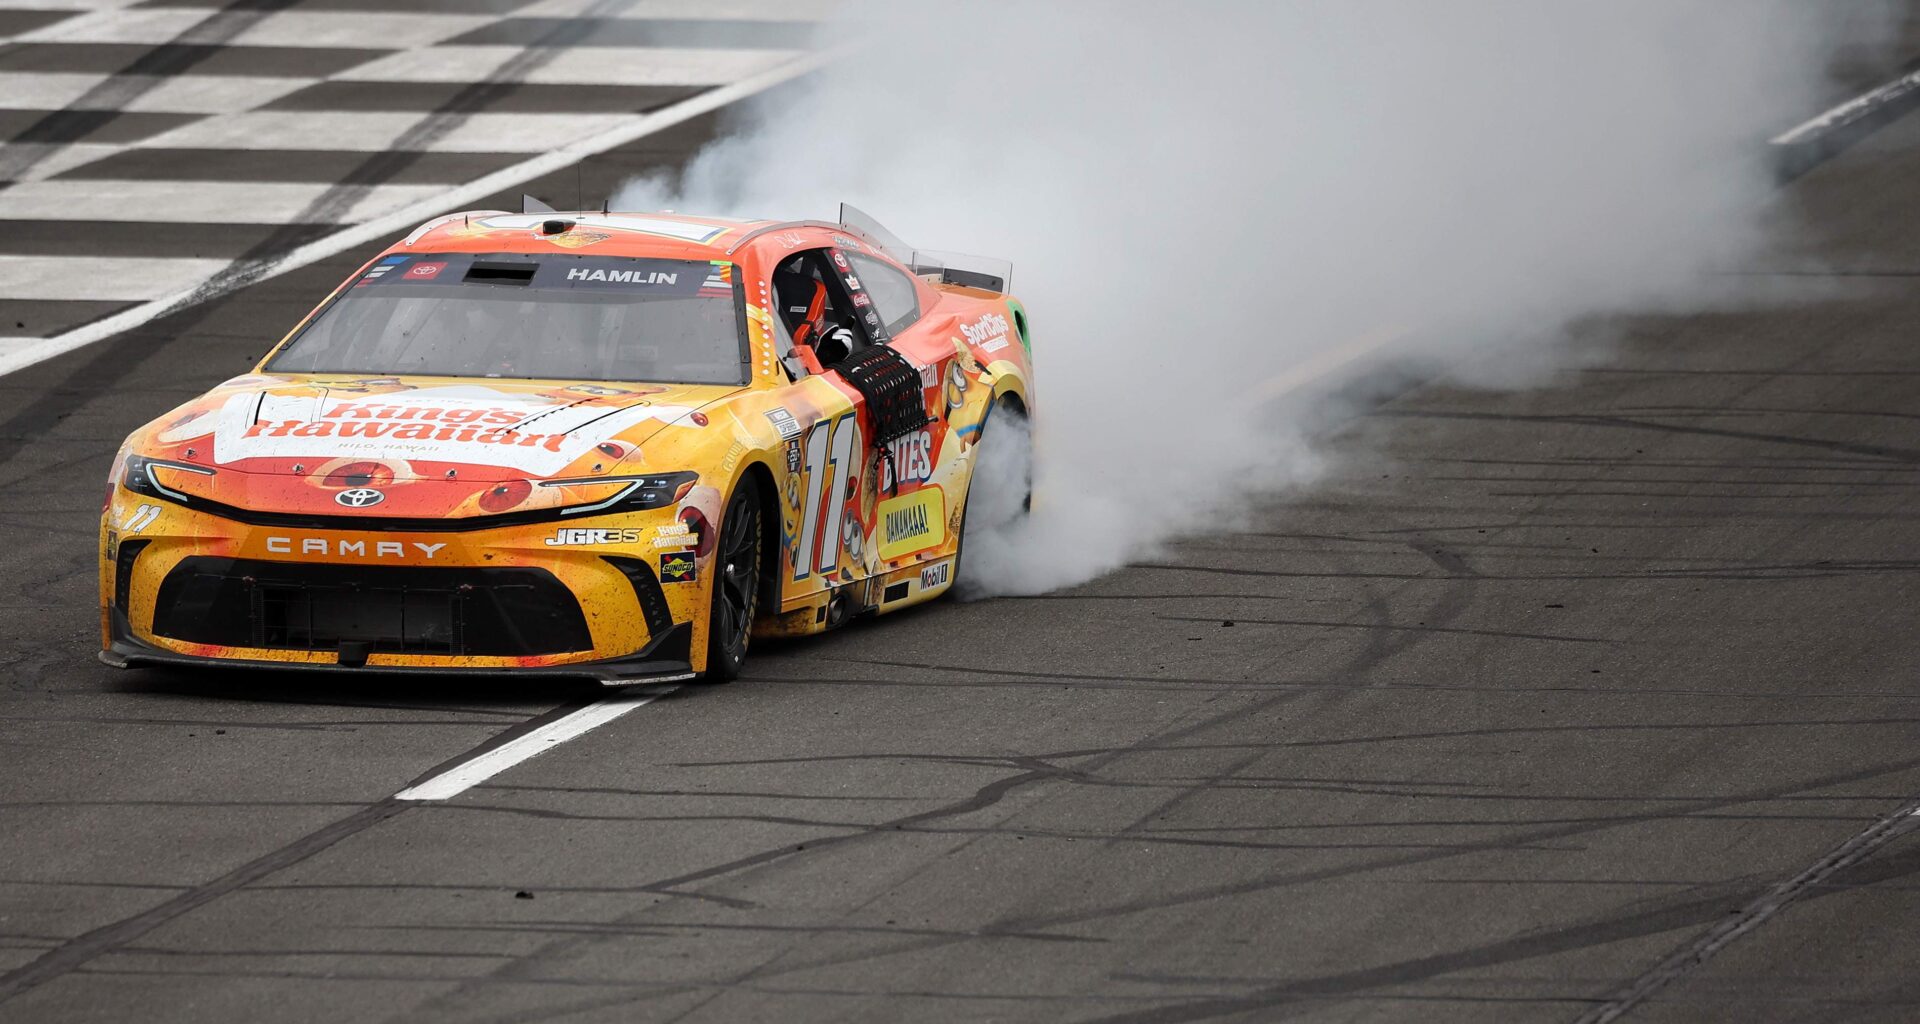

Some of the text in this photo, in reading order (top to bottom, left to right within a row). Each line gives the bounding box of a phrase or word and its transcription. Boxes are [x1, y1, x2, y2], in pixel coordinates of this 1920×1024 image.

[567, 268, 678, 285] HAMLIN
[240, 419, 568, 453] Hawaiian
[338, 442, 440, 452] HILO, HAWAII
[793, 410, 857, 582] 11
[122, 504, 162, 532] 11
[266, 536, 448, 559] CAMRY
[662, 562, 694, 573] SUNOCO
[920, 565, 941, 590] Mobil
